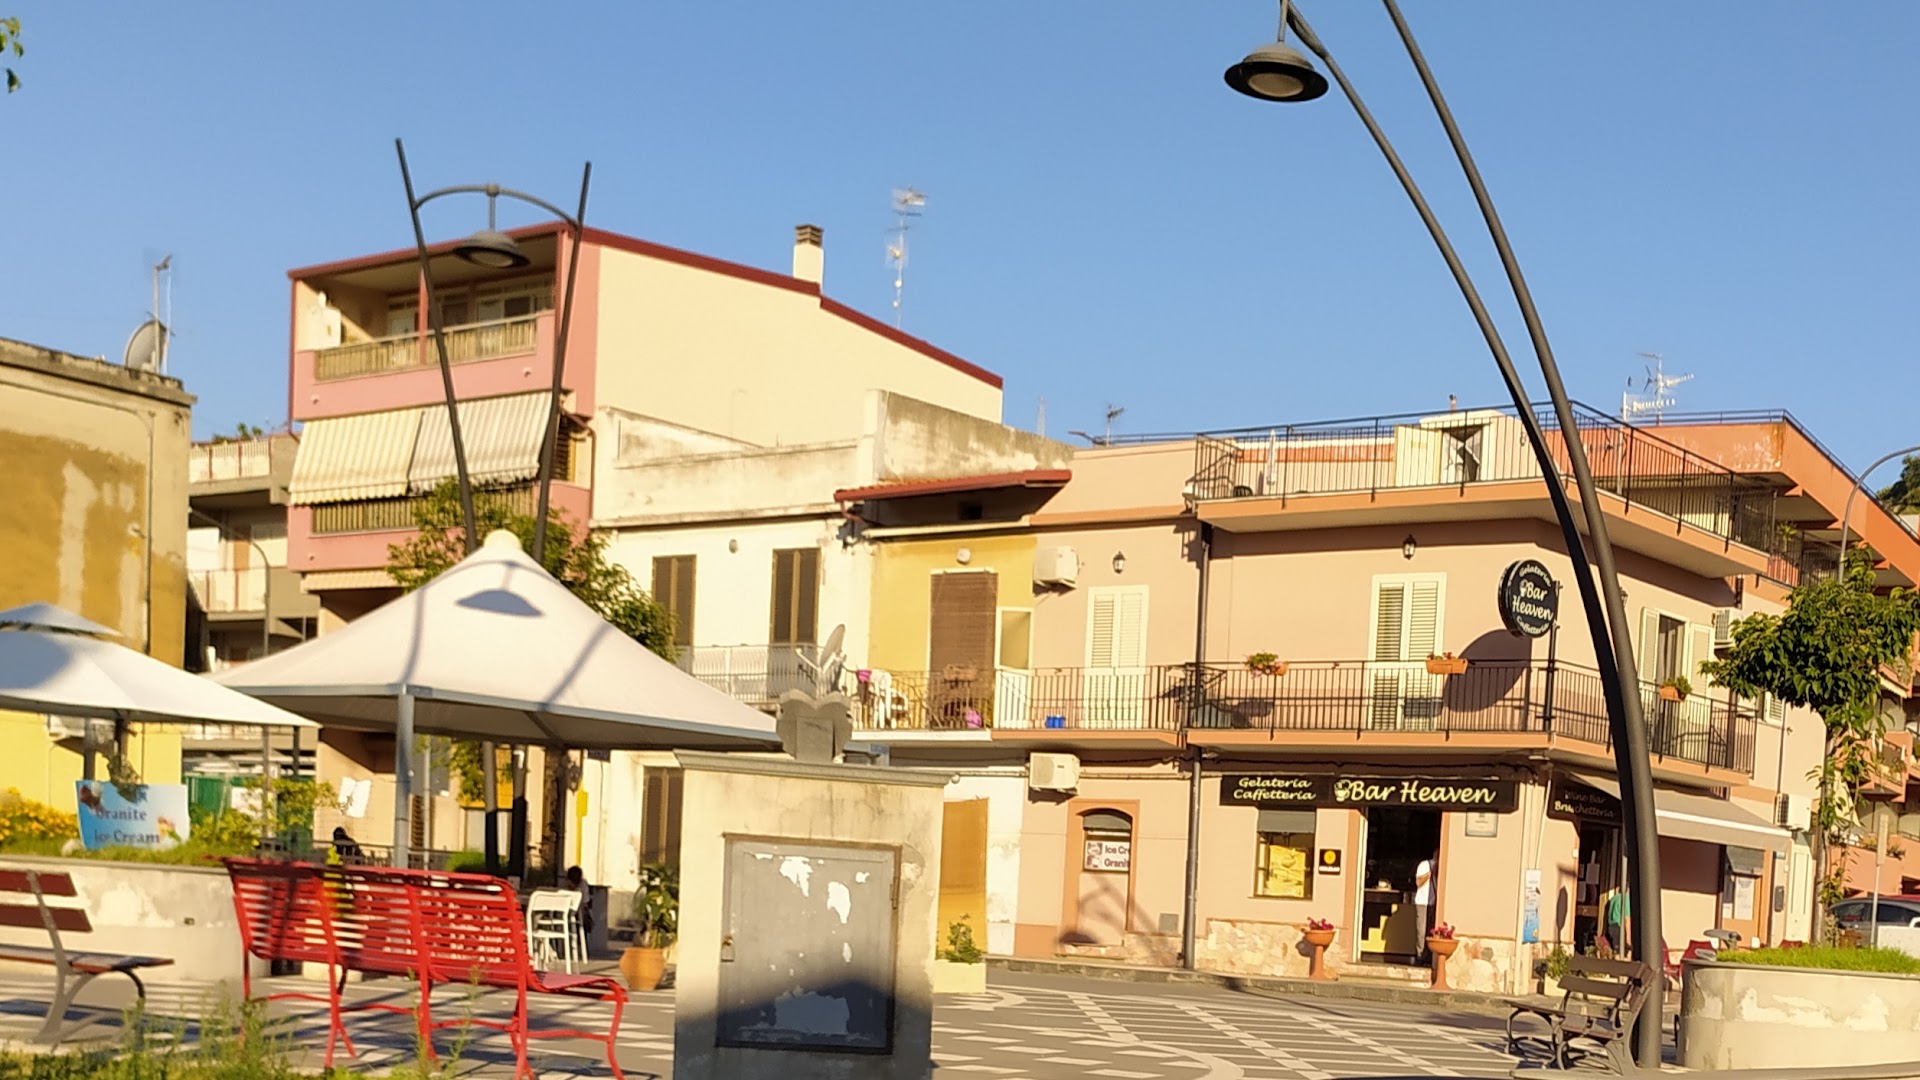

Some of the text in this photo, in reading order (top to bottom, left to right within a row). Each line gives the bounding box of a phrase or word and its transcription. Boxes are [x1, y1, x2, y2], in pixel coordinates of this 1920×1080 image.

[1526, 581, 1549, 601] Bar
[1512, 595, 1554, 621] Heaven
[1238, 777, 1313, 788] Gelateria
[1233, 788, 1317, 801] Caffetteria
[1350, 780, 1497, 803] Bar Heaven
[114, 829, 161, 843] Cream
[1118, 846, 1130, 855] Cr
